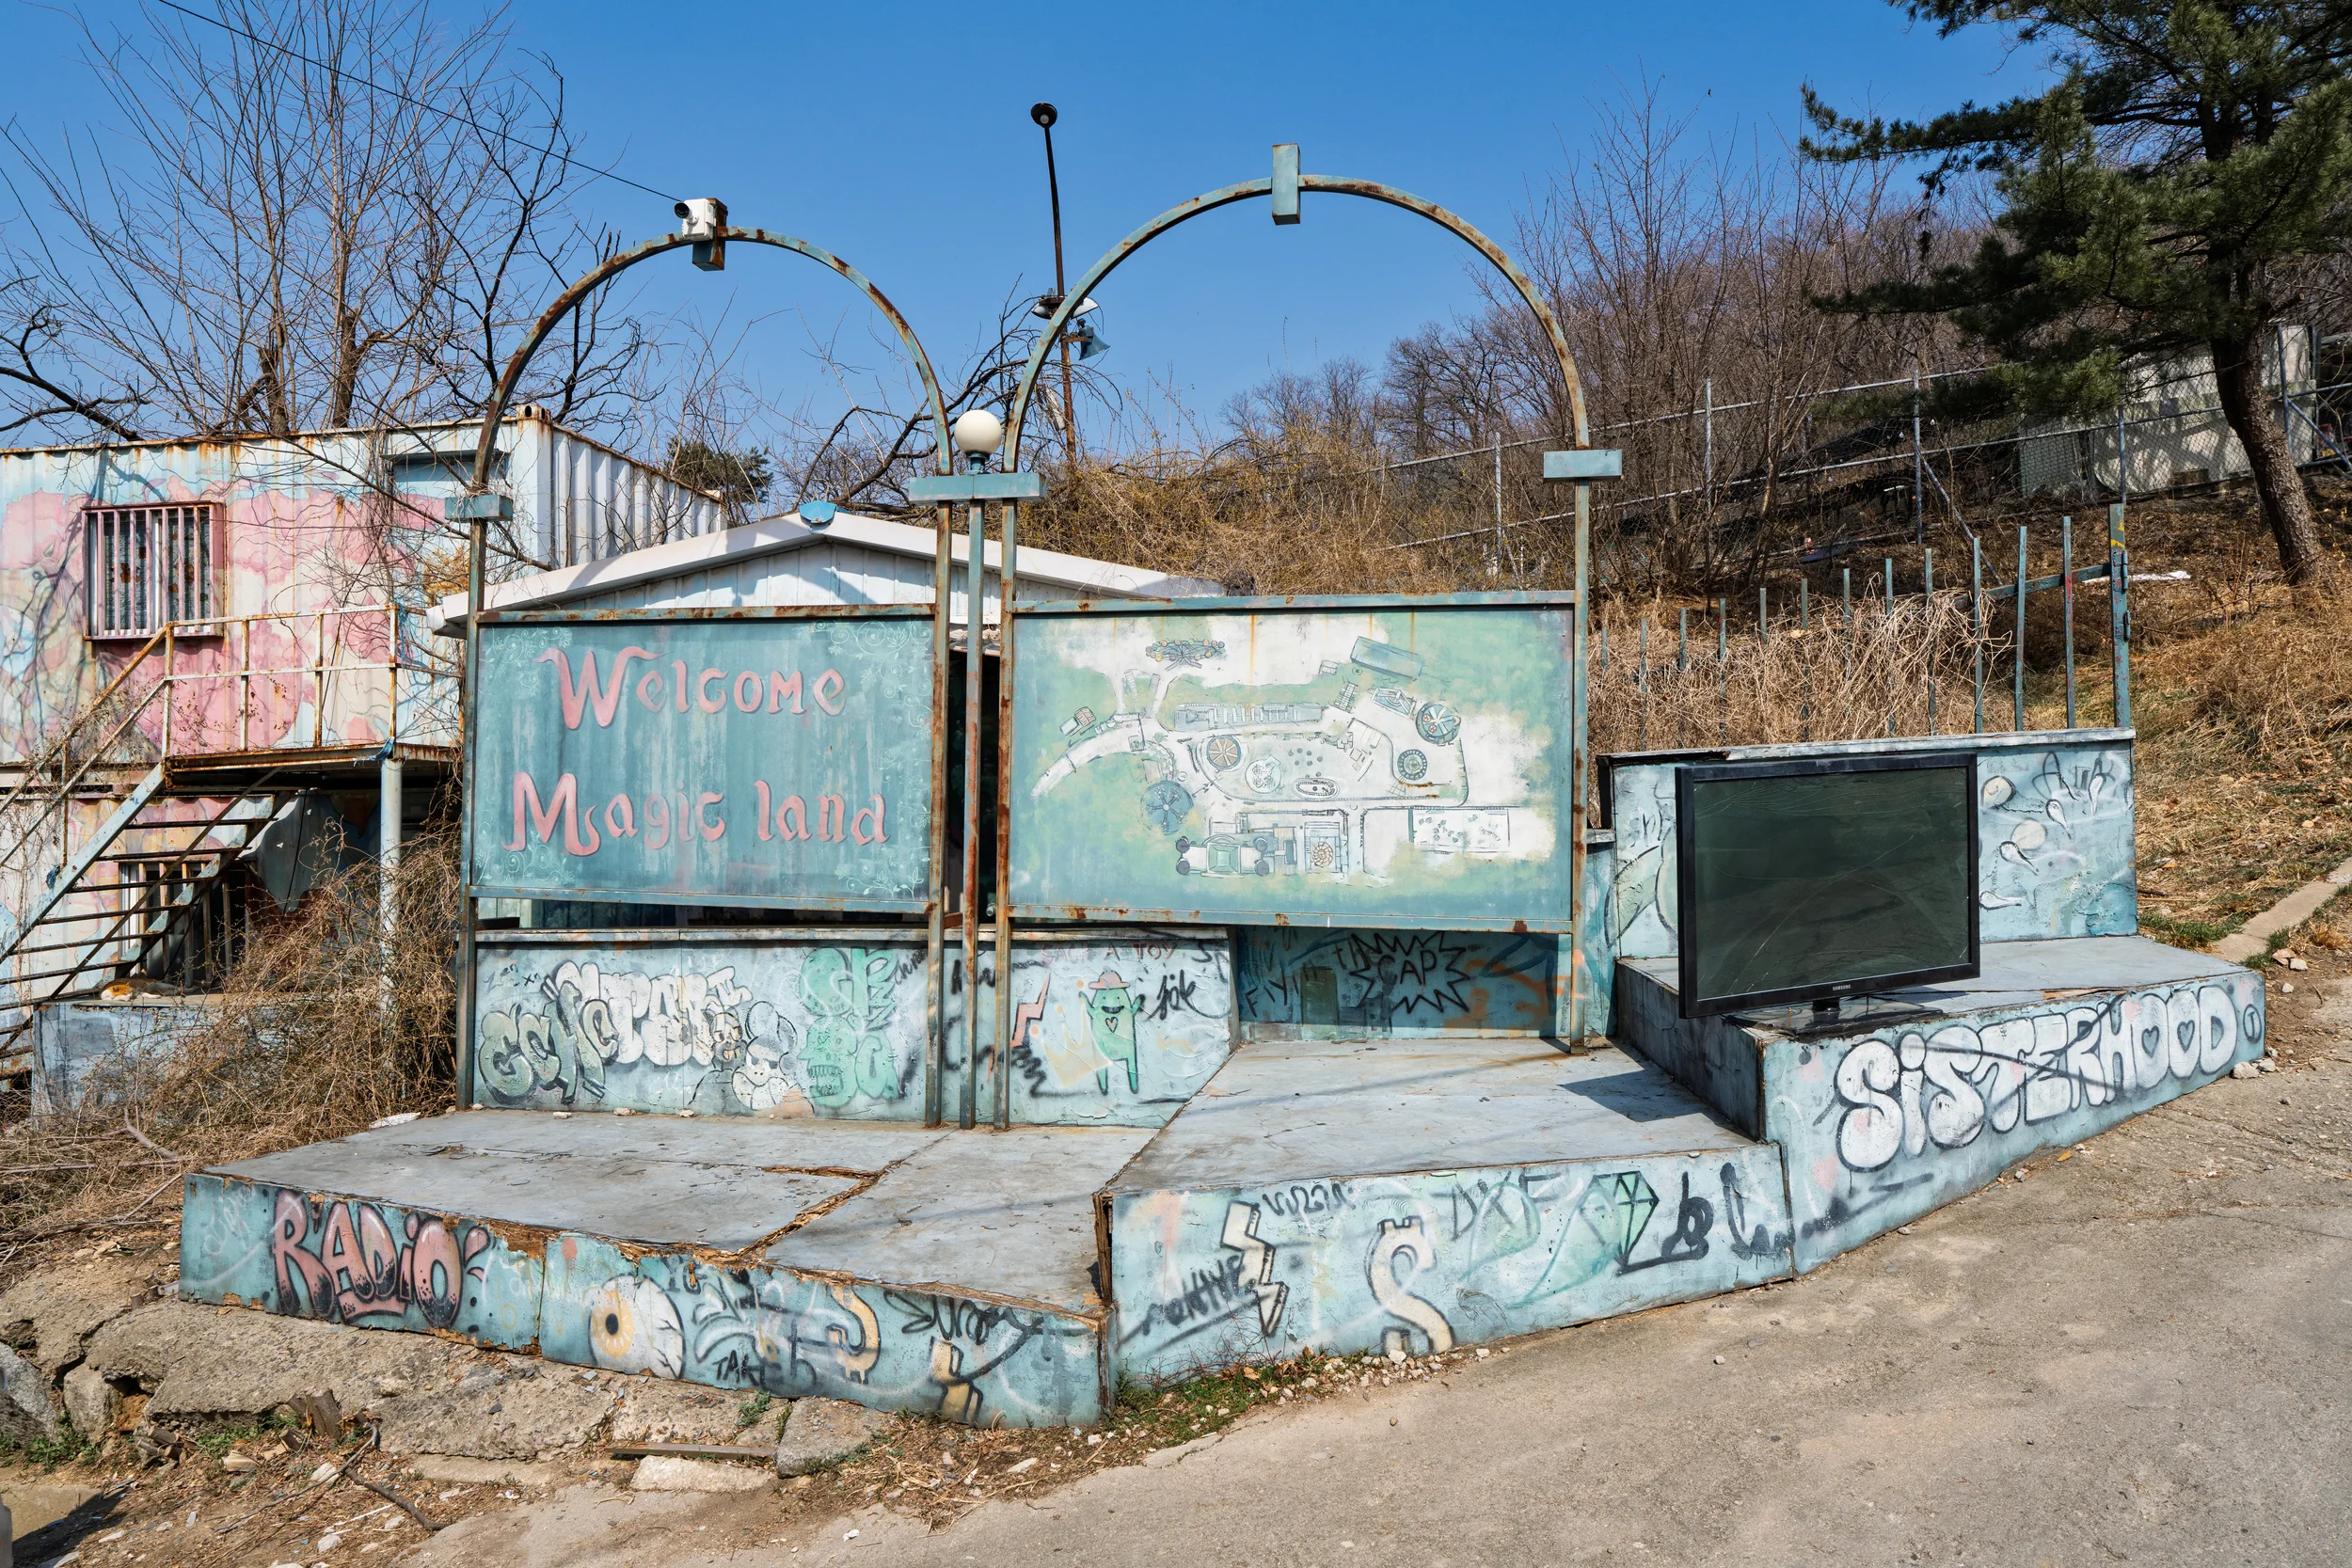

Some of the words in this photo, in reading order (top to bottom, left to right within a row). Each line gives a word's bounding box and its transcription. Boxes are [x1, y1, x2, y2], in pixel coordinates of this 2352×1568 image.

[535, 645, 845, 730] Welcome
[501, 771, 726, 857] Magic
[754, 779, 891, 846] land
[1132, 941, 1178, 960] TOY
[1377, 949, 1438, 987] CAP
